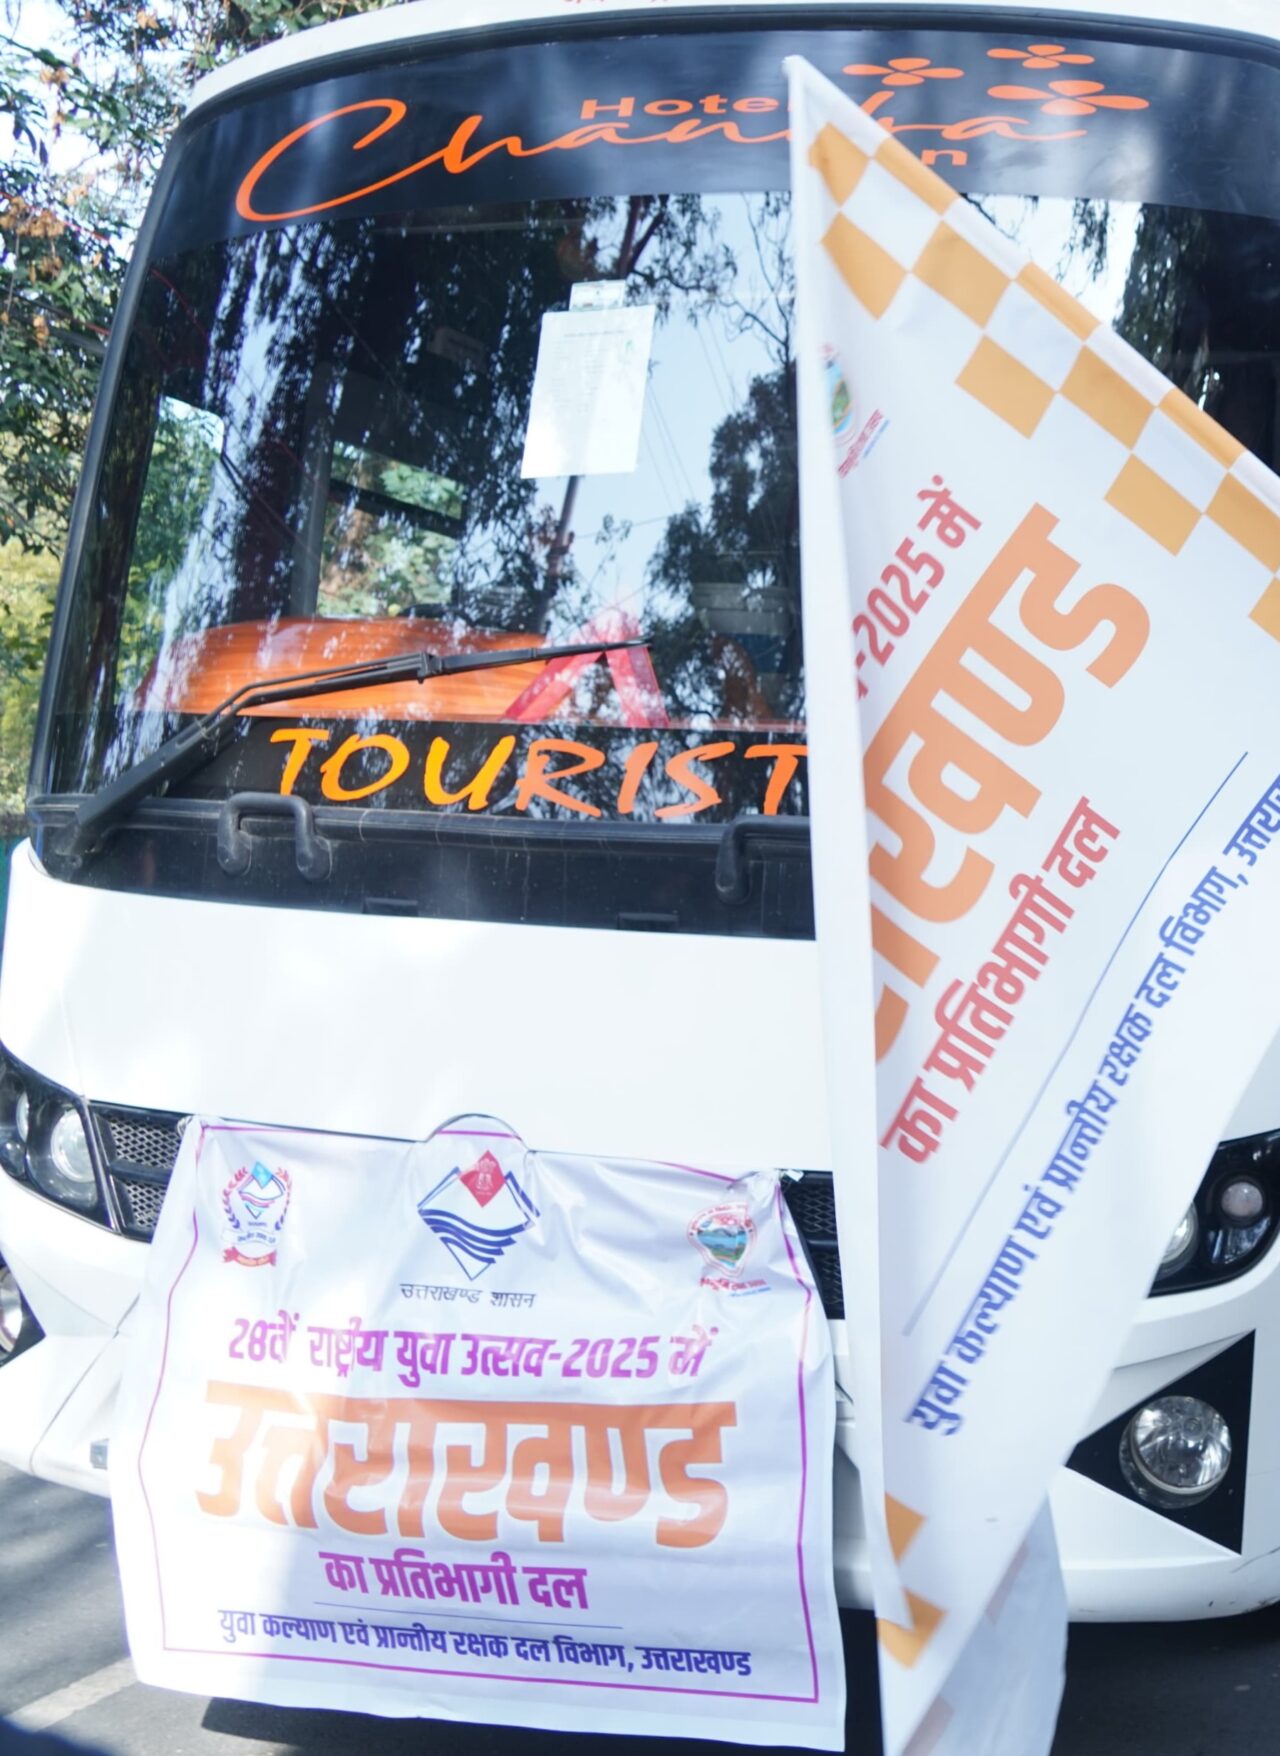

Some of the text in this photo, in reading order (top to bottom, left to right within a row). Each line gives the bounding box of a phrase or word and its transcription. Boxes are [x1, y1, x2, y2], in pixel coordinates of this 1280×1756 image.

[580, 93, 790, 120] Hote
[853, 537, 945, 699] -2025
[916, 474, 982, 549] में
[270, 728, 807, 818] TOURIST
[1159, 865, 1249, 957] विभाग,
[880, 796, 1121, 1164] का प्रतिभागी दल
[1134, 952, 1187, 1009] दल
[1098, 1002, 1153, 1087] रक्षक
[1042, 1079, 1118, 1193] प्रान्तीय
[1013, 1183, 1065, 1240] एवं
[399, 1283, 537, 1309] उत्तराखण्ड शासन
[944, 1234, 1039, 1364] कल्याण
[307, 1317, 389, 1378] राष्ट्रीय
[394, 1331, 456, 1388] युवा
[461, 1333, 661, 1379] उत्सव-2025
[670, 1324, 719, 1377] में
[904, 1360, 971, 1436] युवा
[195, 1380, 737, 1548] उत्तराखण्ड
[318, 1547, 589, 1610] का प्रतिभागी दल
[218, 1610, 752, 1676] युवा कल्याण एवं प्रान्तीय रक्षक दल विभाग, उत्तराखण्ड
